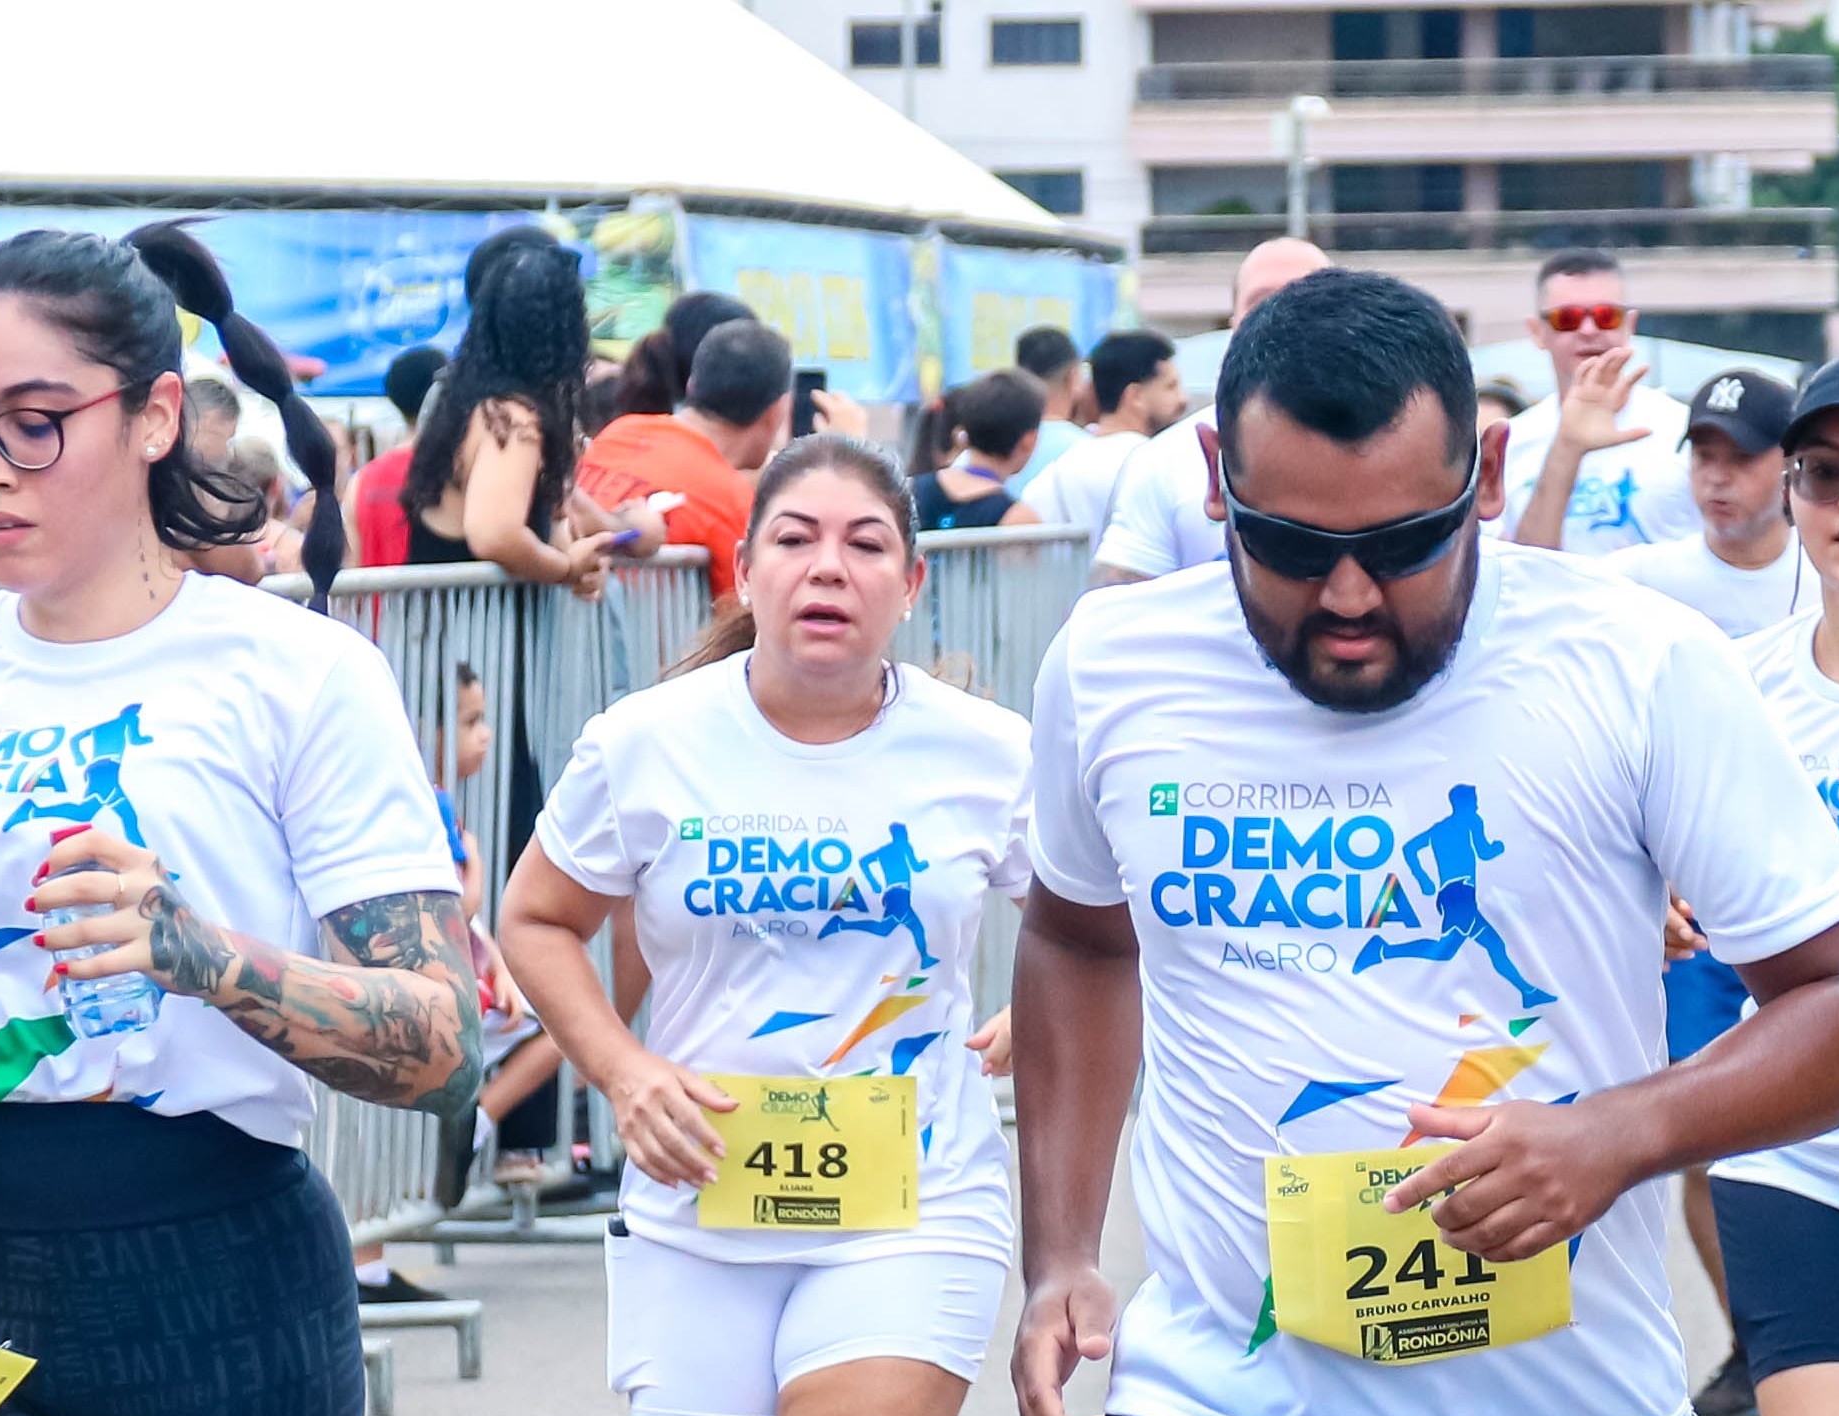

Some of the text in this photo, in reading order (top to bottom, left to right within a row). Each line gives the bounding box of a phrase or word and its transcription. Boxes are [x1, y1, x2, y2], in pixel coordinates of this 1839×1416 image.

[1183, 782, 1335, 810] CORRIDA
[1347, 782, 1393, 809] DA
[707, 814, 809, 834] CORRIDA
[817, 815, 849, 834] DA
[707, 836, 852, 875] DEMO
[1182, 814, 1394, 870] DEMO
[684, 875, 870, 916] CRACIA
[1150, 871, 1422, 930] CRACIA
[1219, 941, 1338, 973] AleRO
[768, 1090, 810, 1102] DEMO
[743, 1141, 849, 1179] 418
[777, 1203, 840, 1220] RONDÔNIA
[1345, 1239, 1497, 1300] 241
[1355, 1292, 1491, 1318] BRUNO CARVALHO
[1398, 1327, 1489, 1351] RONDÔNIA
